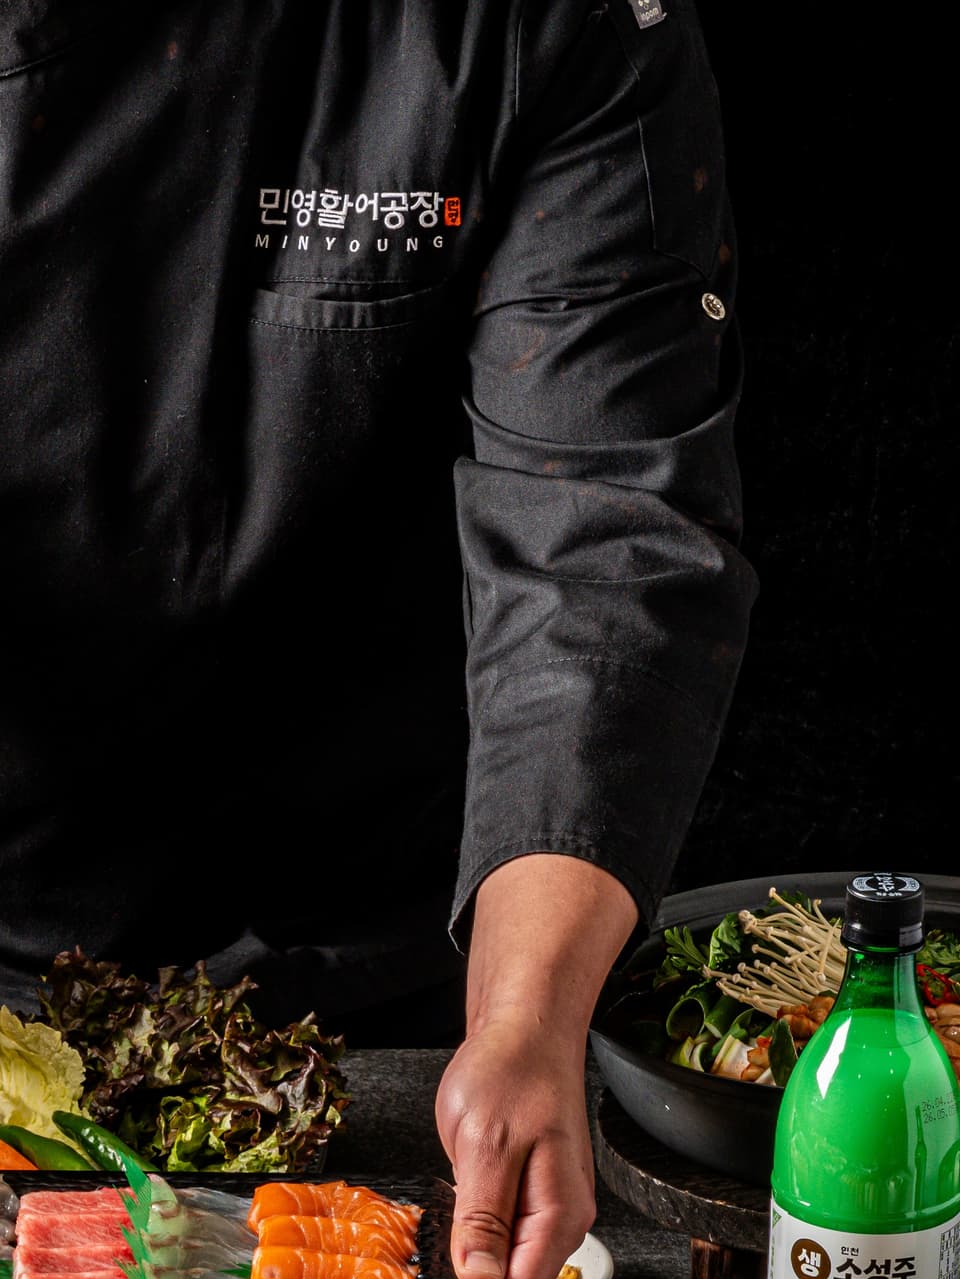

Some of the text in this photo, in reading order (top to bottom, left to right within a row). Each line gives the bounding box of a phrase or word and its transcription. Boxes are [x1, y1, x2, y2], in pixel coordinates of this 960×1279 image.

[259, 188, 444, 230] 민영활어공장
[254, 233, 444, 253] MINYOUNG
[798, 1248, 822, 1277] 생
[840, 1246, 859, 1257] 인천
